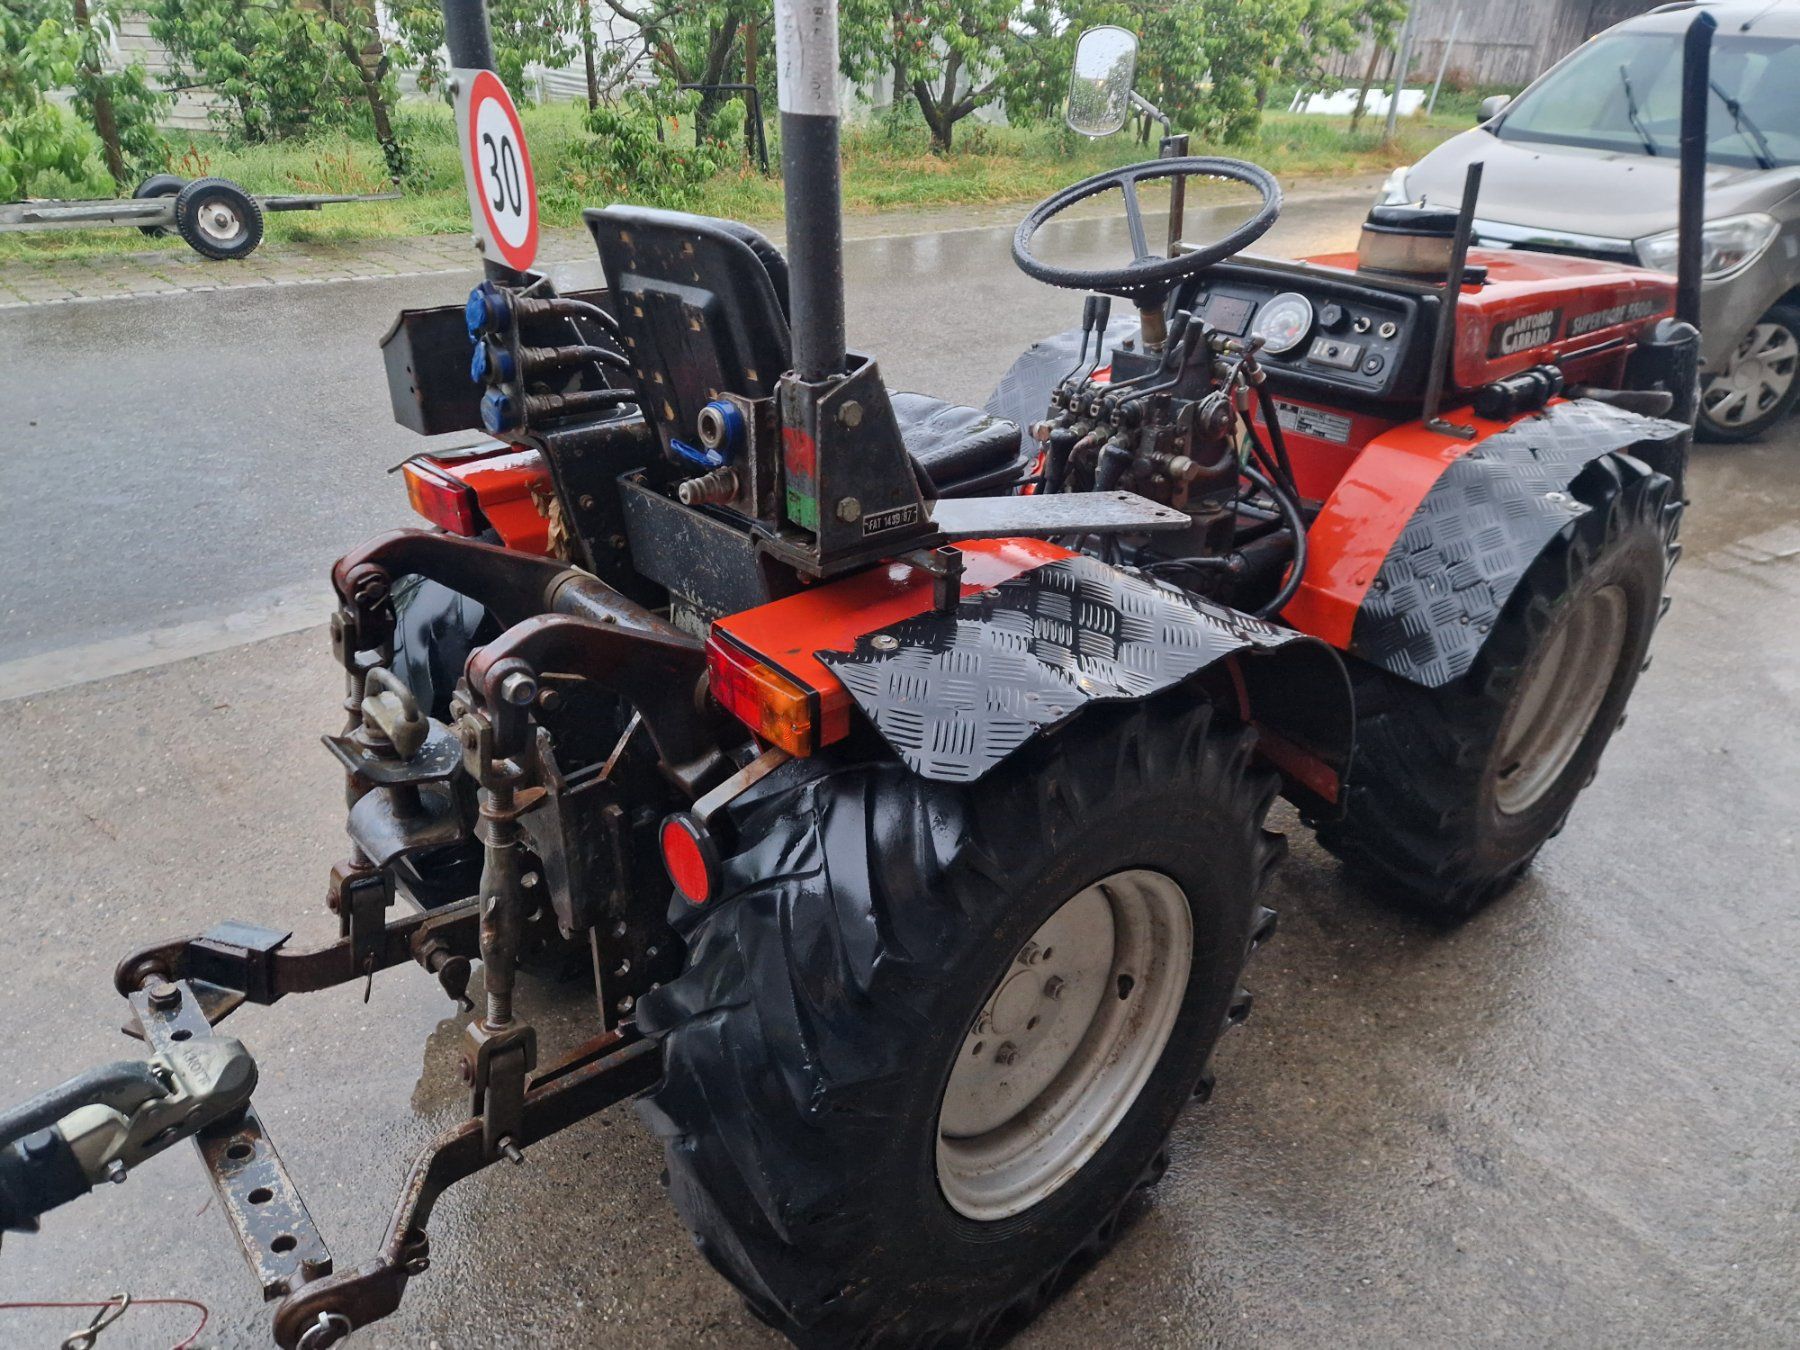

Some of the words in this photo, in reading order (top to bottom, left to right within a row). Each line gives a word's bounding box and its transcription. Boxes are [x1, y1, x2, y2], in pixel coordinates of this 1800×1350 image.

[482, 132, 521, 217] 30
[1513, 309, 1554, 333] ANTONIO
[1501, 325, 1551, 354] CARRARO
